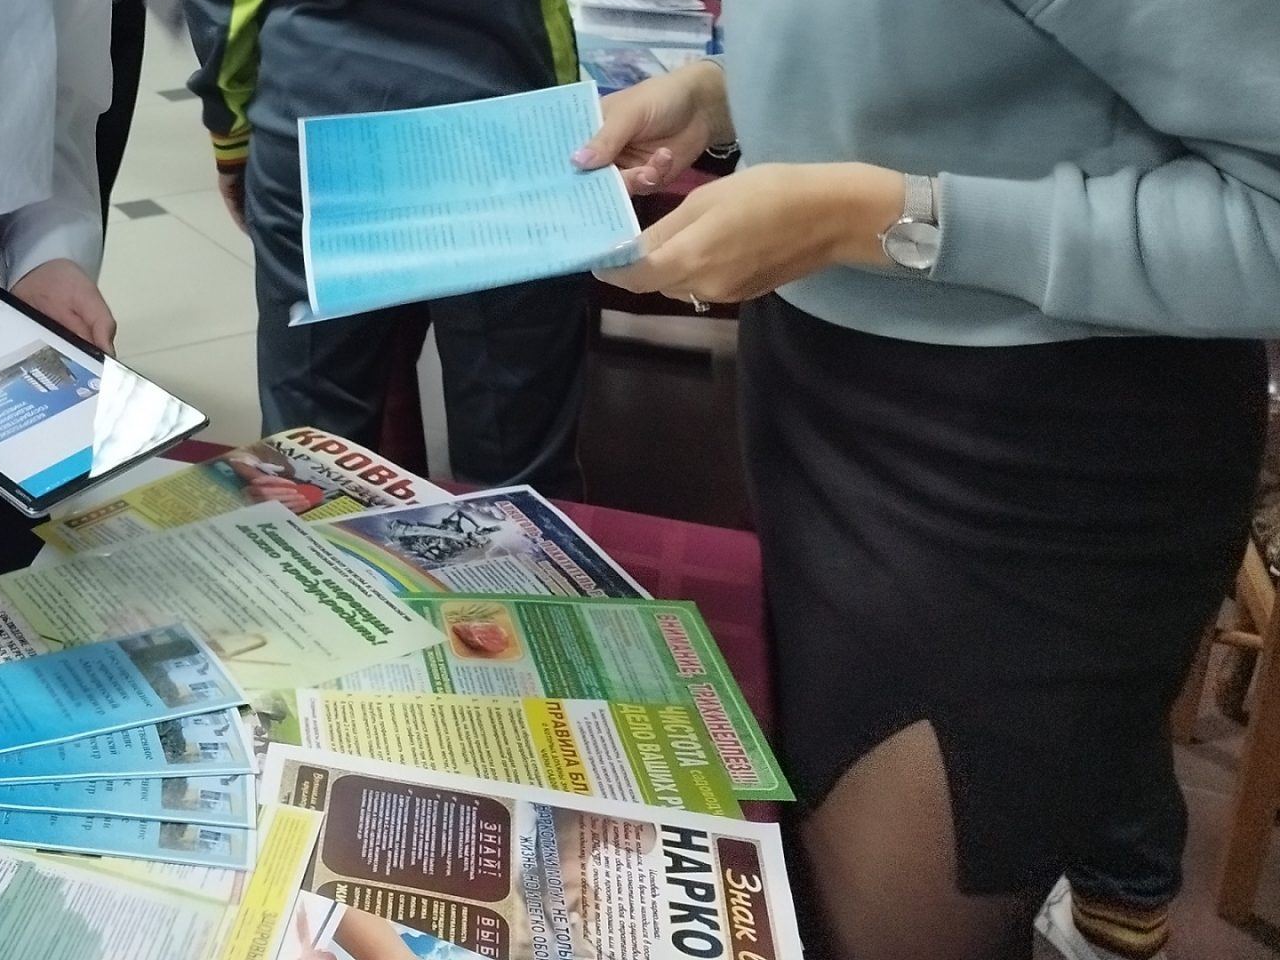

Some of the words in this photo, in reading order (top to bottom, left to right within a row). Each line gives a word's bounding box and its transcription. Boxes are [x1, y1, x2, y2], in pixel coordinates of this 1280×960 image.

[545, 702, 579, 764] ПРАВИЛА
[568, 771, 589, 793] БЛ
[617, 704, 656, 741] ДЕЛО
[658, 706, 708, 767] ЧИСТОТА
[636, 743, 678, 792] ВАШИХ
[482, 822, 497, 876] ЗНАЙ!
[535, 803, 558, 865] НАРКОТИКИ
[335, 883, 347, 903] ЖИ
[545, 870, 565, 904] МОГУТ
[551, 905, 567, 923] НЕ
[660, 824, 723, 958] НАРКО
[725, 868, 762, 941] Знак
